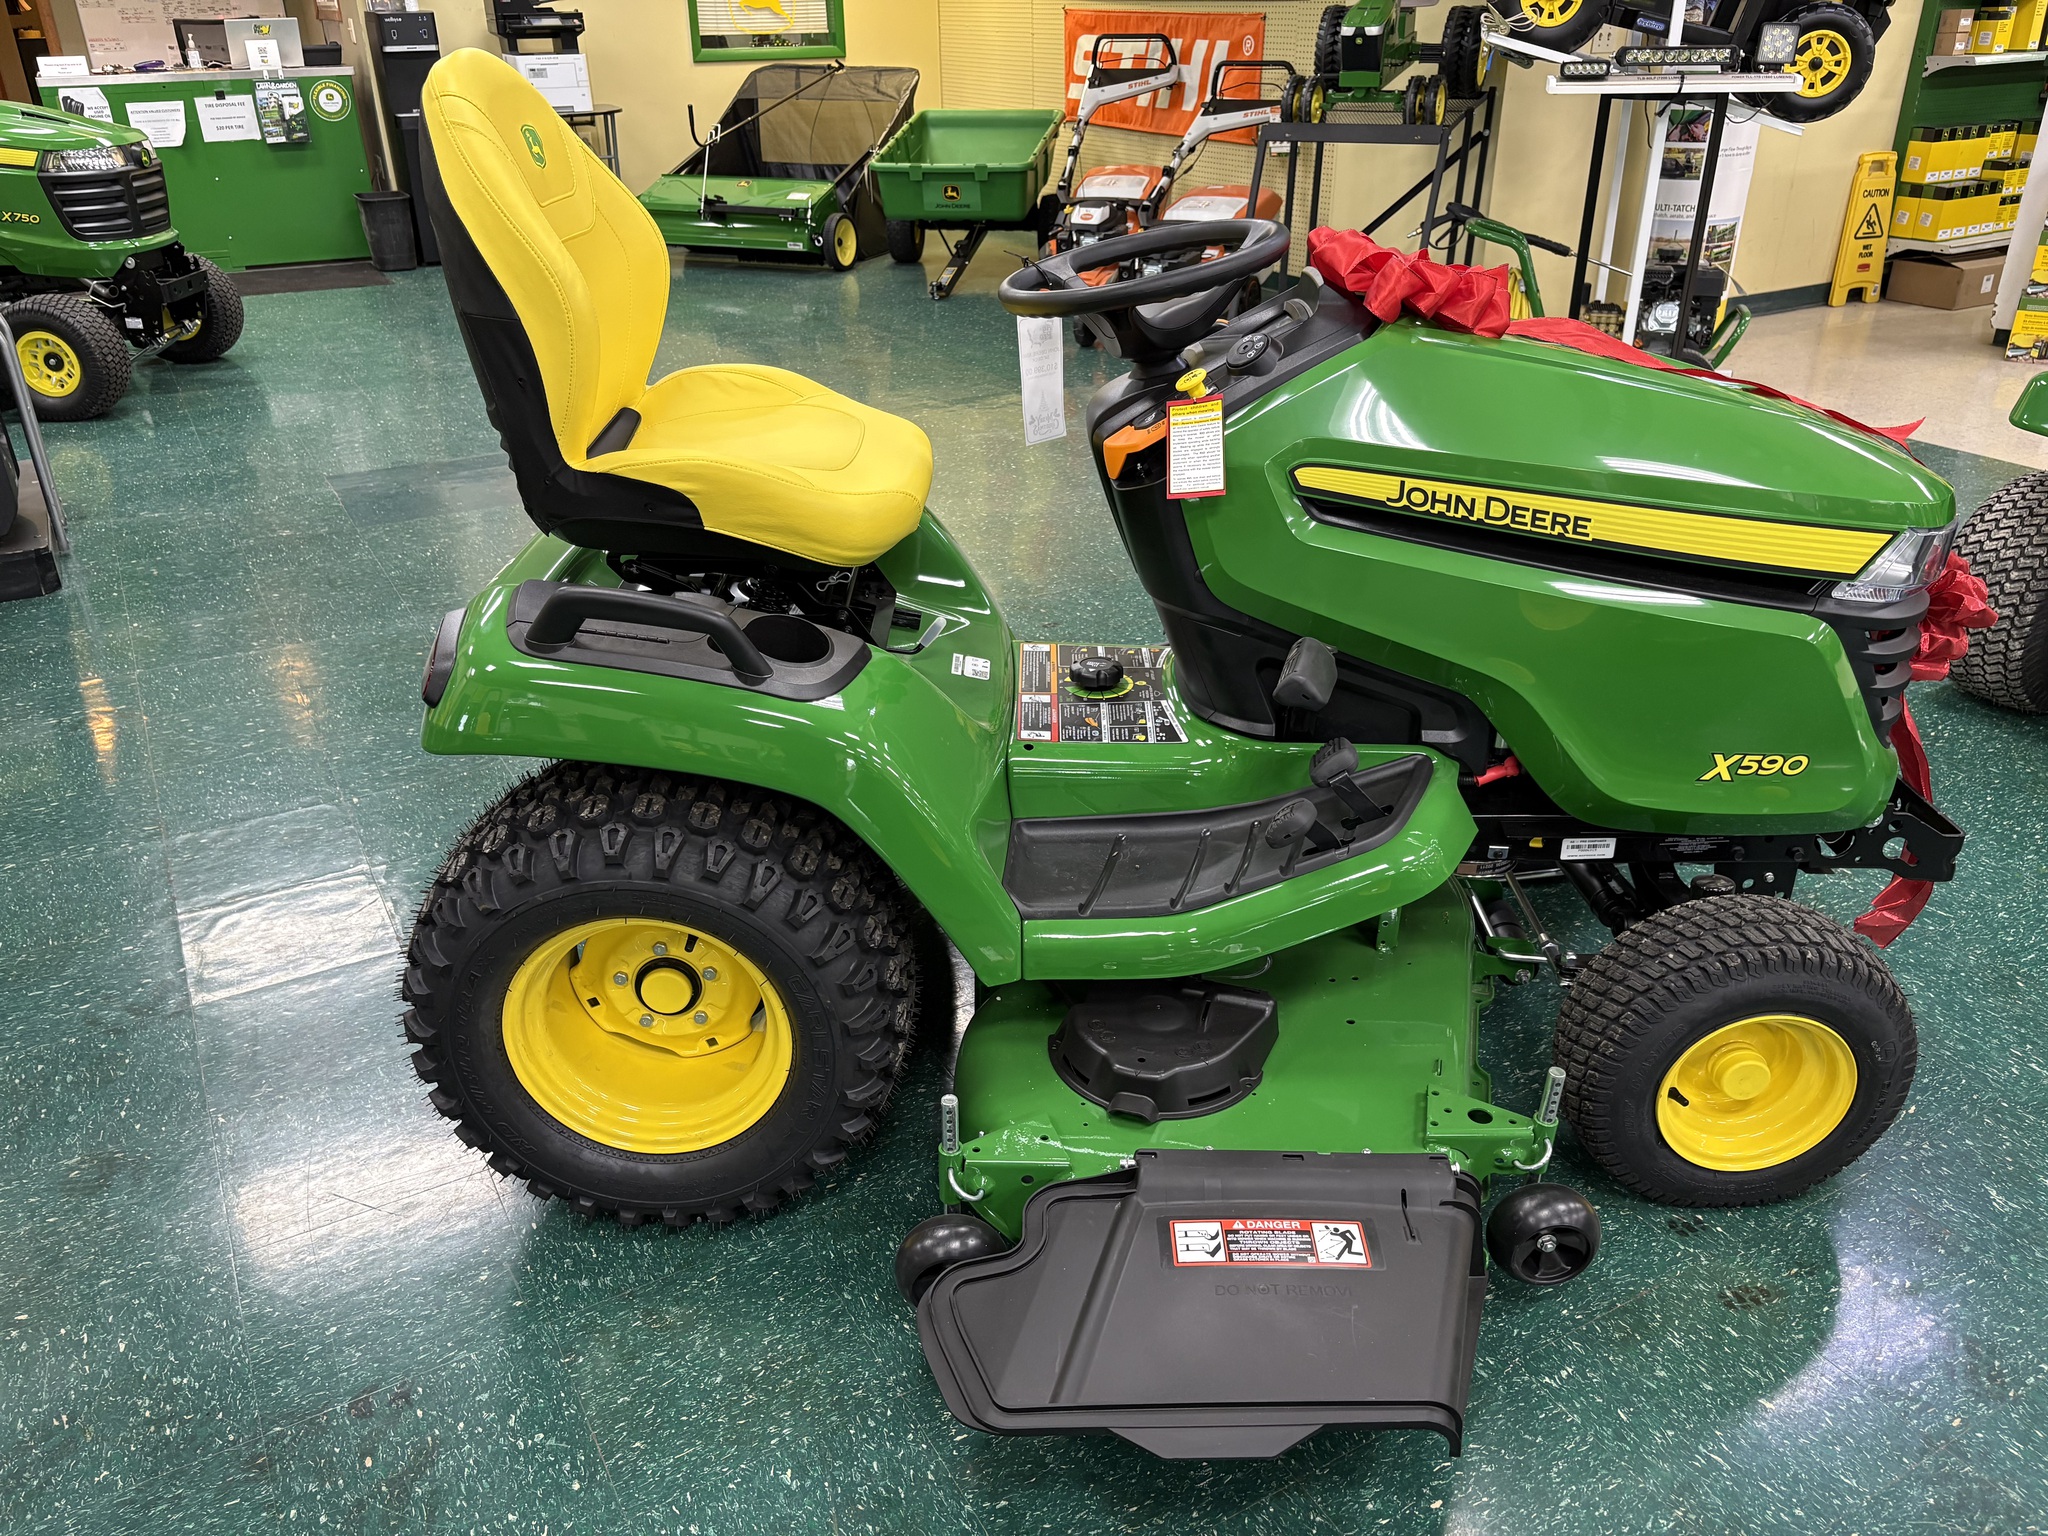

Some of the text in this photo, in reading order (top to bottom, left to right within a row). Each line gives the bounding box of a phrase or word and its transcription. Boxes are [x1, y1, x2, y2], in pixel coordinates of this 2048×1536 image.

[1127, 79, 1152, 90] STIHL
[326, 82, 347, 100] FINANCING
[1242, 109, 1269, 118] STIHL
[1862, 187, 1890, 199] CAUTION
[1, 210, 41, 224] X750
[1862, 243, 1873, 251] WET
[1858, 251, 1874, 259] FLOOR
[1386, 480, 1592, 538] JOHN DEERE
[1695, 752, 1810, 782] X590
[786, 972, 831, 1122] CARLSTAR
[1246, 1221, 1300, 1229] DANGER
[1214, 1285, 1239, 1296] DO
[1245, 1284, 1280, 1295] NOT
